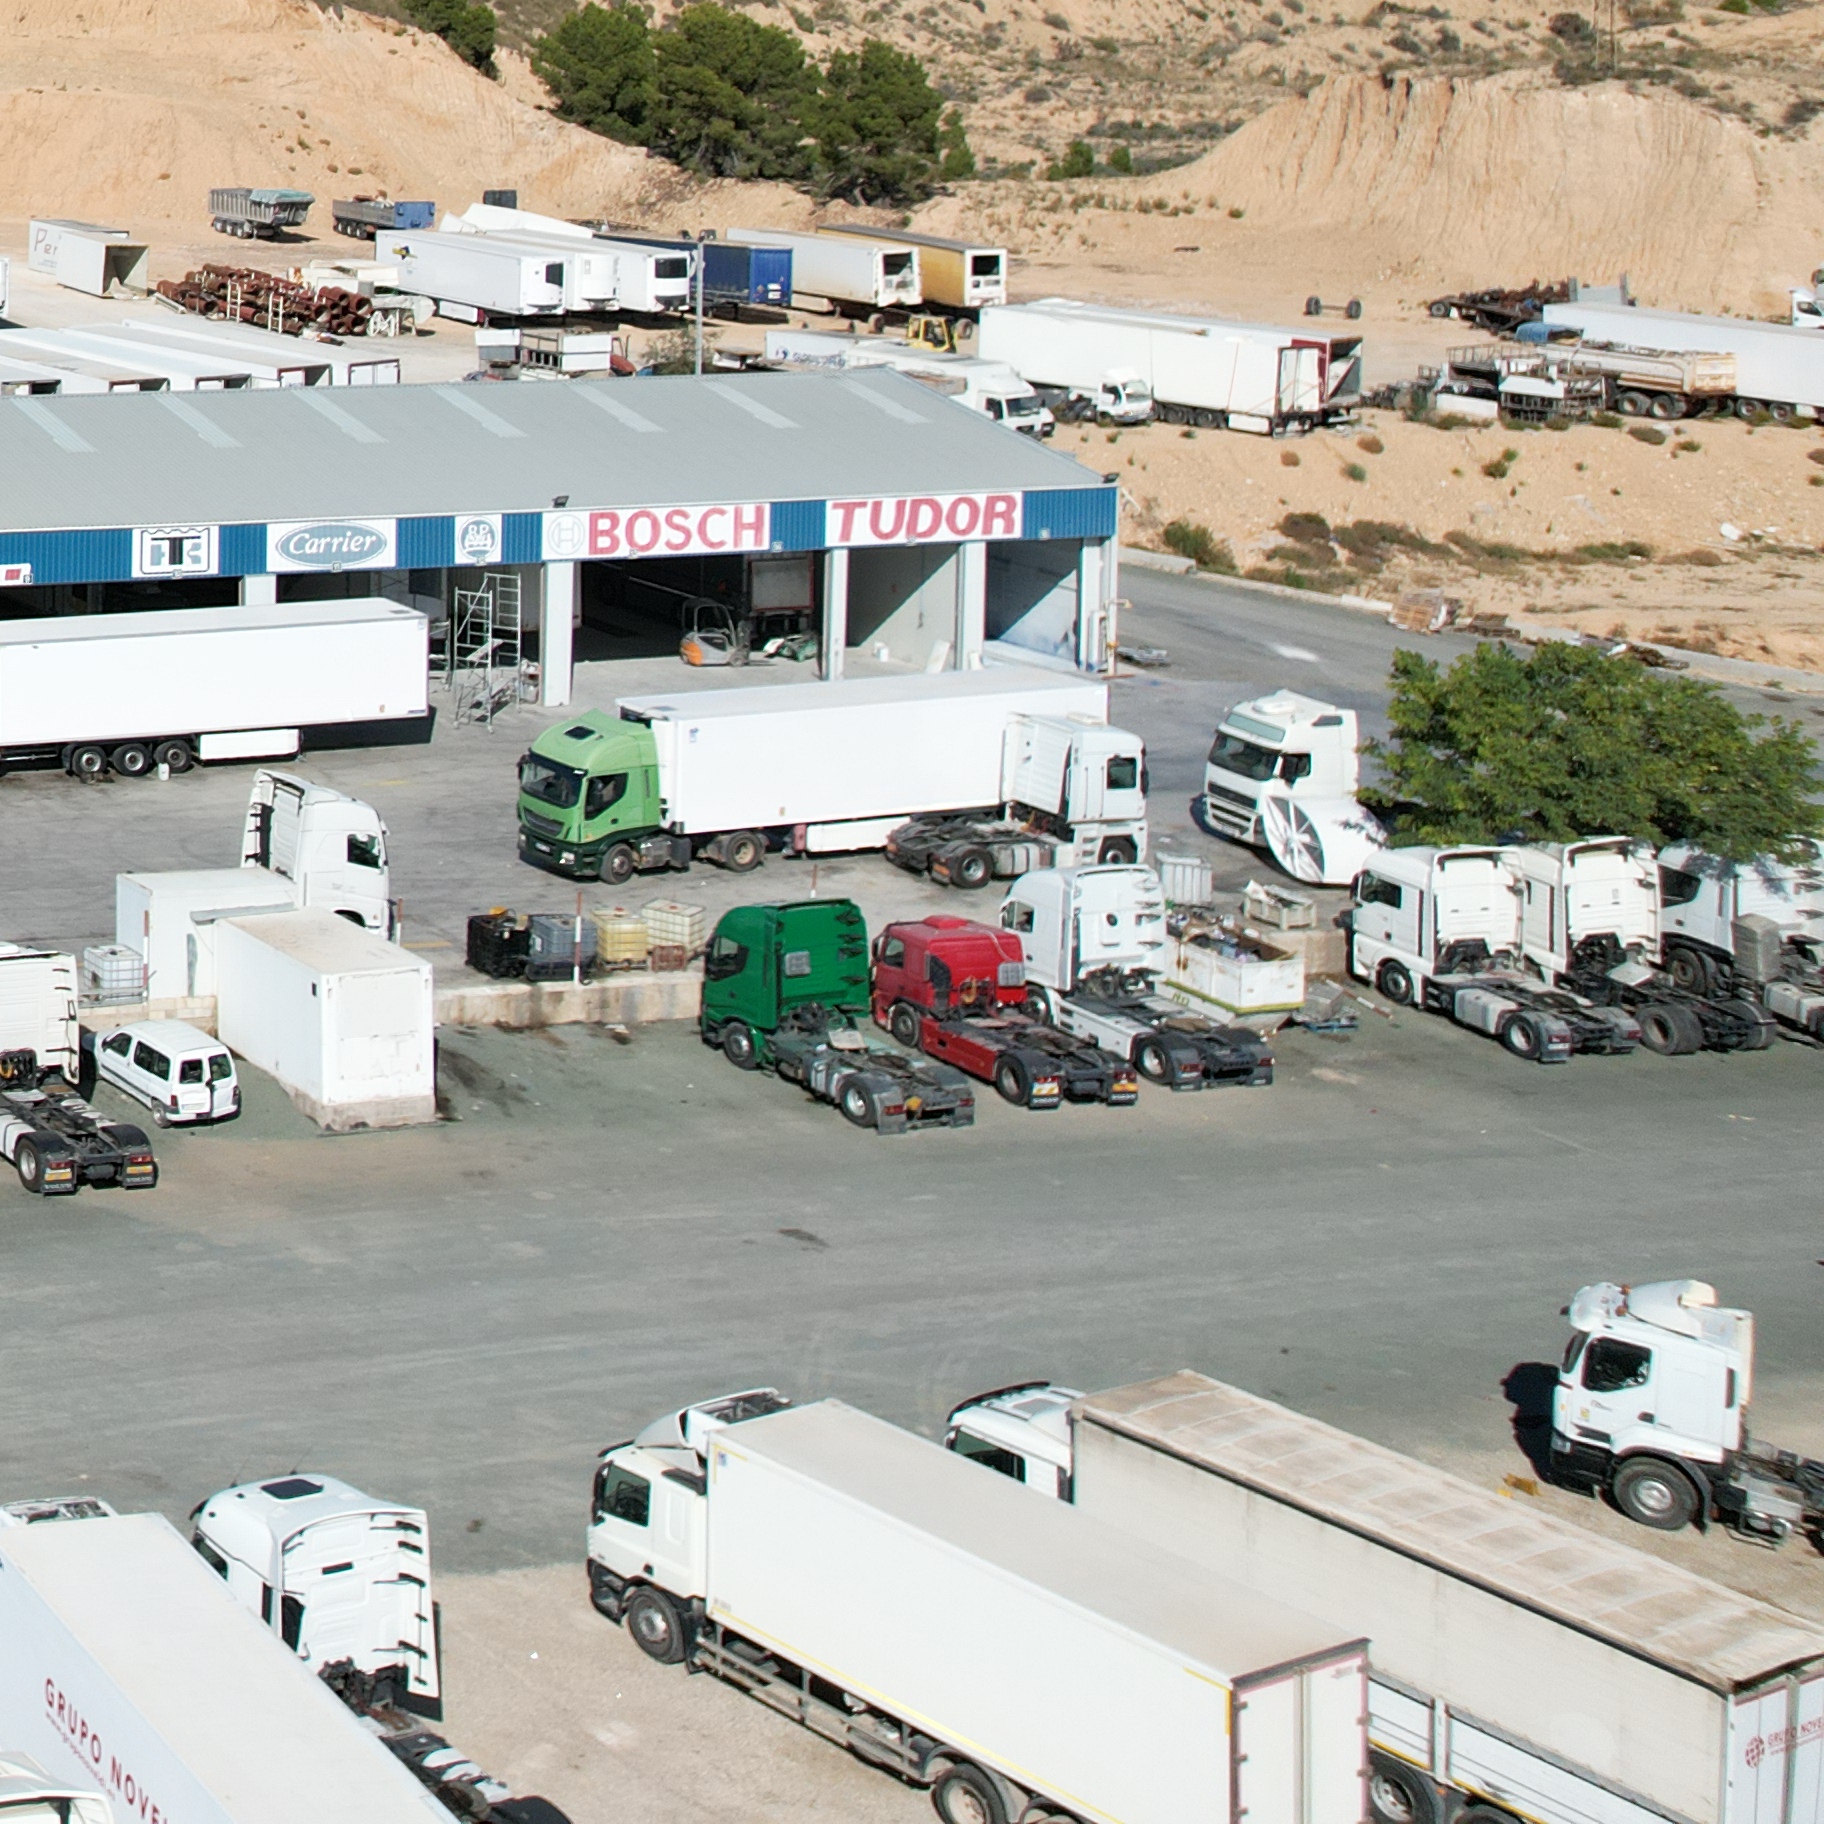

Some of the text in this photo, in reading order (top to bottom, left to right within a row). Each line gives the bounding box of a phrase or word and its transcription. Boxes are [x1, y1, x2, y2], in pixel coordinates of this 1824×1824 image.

[289, 531, 377, 556] Carrier
[588, 504, 765, 556] BOSCH
[832, 494, 1018, 543] TUDOR
[45, 1678, 169, 1824] GRUPO NOVE
